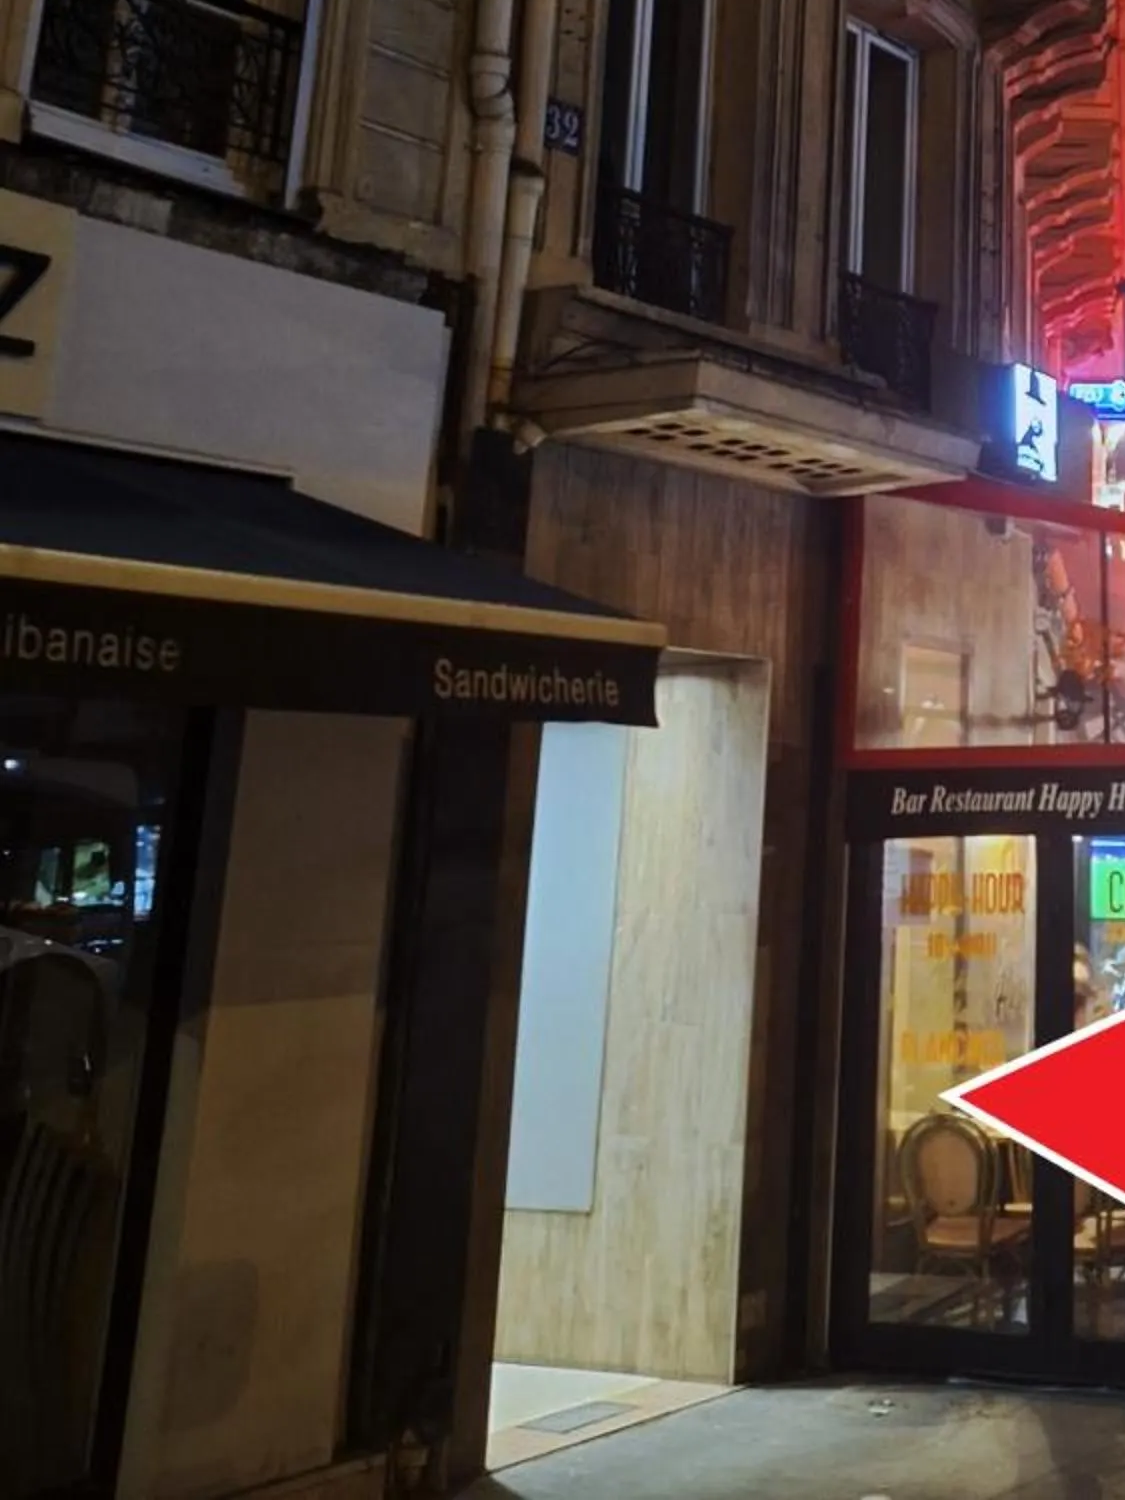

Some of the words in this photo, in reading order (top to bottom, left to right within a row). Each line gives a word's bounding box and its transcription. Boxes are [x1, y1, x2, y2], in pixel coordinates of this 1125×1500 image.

[548, 104, 579, 147] 32
[433, 657, 620, 706] Sandwicherie
[891, 786, 927, 815] Bar
[930, 785, 1035, 813] Restaurant
[1038, 782, 1103, 819] Happy
